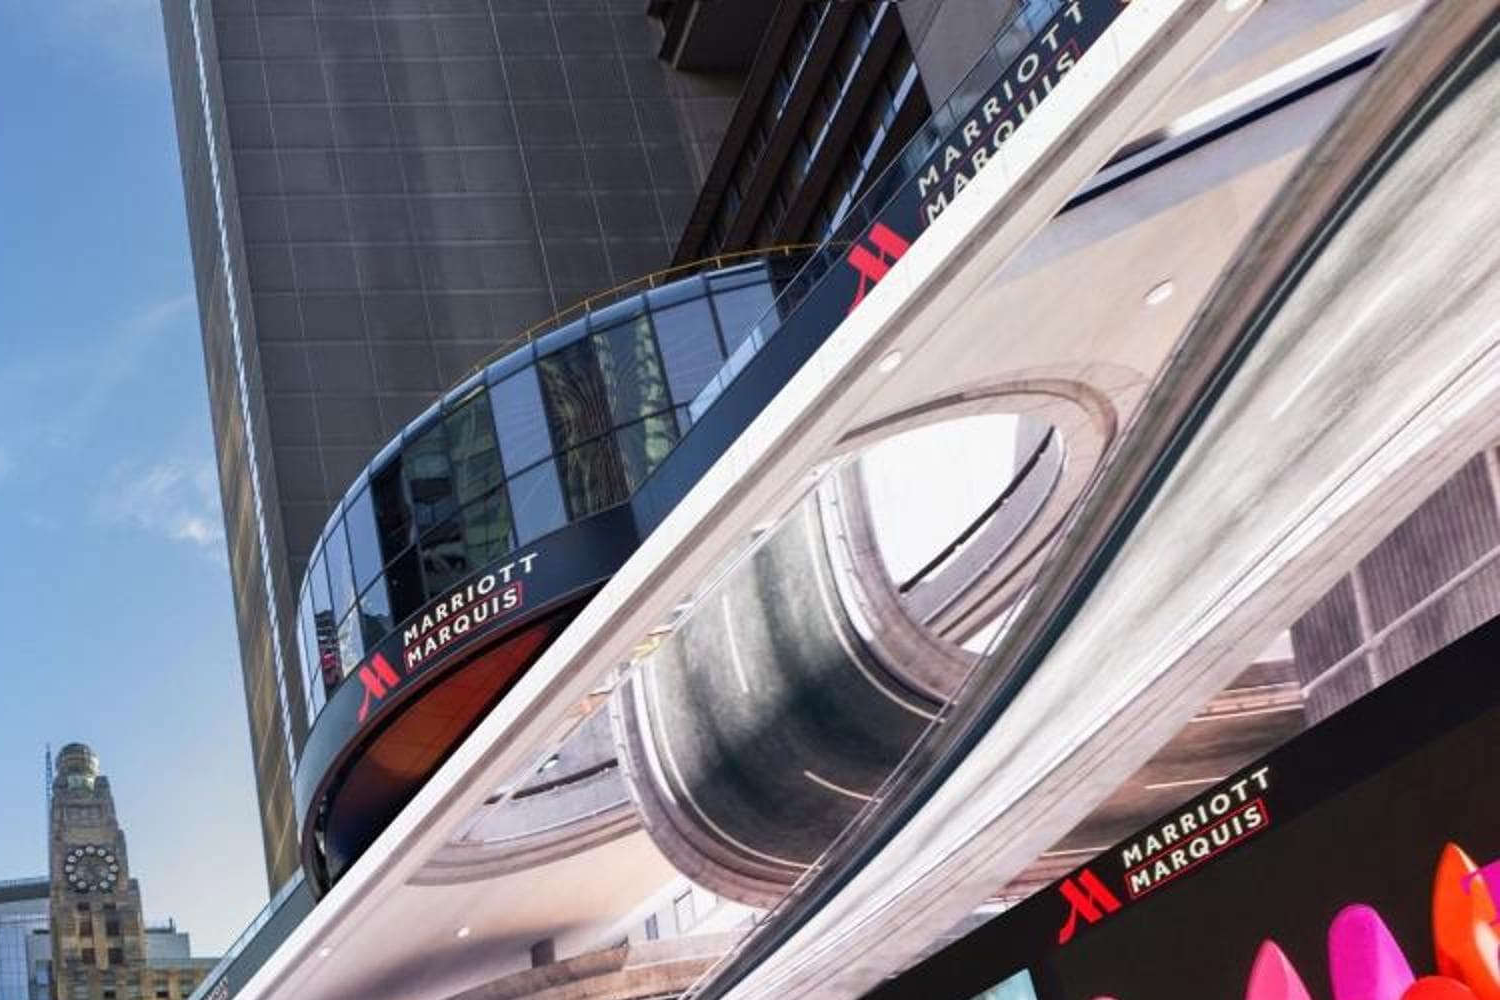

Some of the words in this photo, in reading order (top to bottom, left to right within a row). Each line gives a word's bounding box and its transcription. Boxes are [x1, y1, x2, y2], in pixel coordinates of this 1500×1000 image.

[918, 1, 1084, 198] MARRIOTT
[403, 552, 540, 646] MARRIOTT
[406, 585, 519, 669] MARQUIS
[1121, 767, 1271, 869] MARRIOTT
[1129, 805, 1265, 894] MARQUIS
